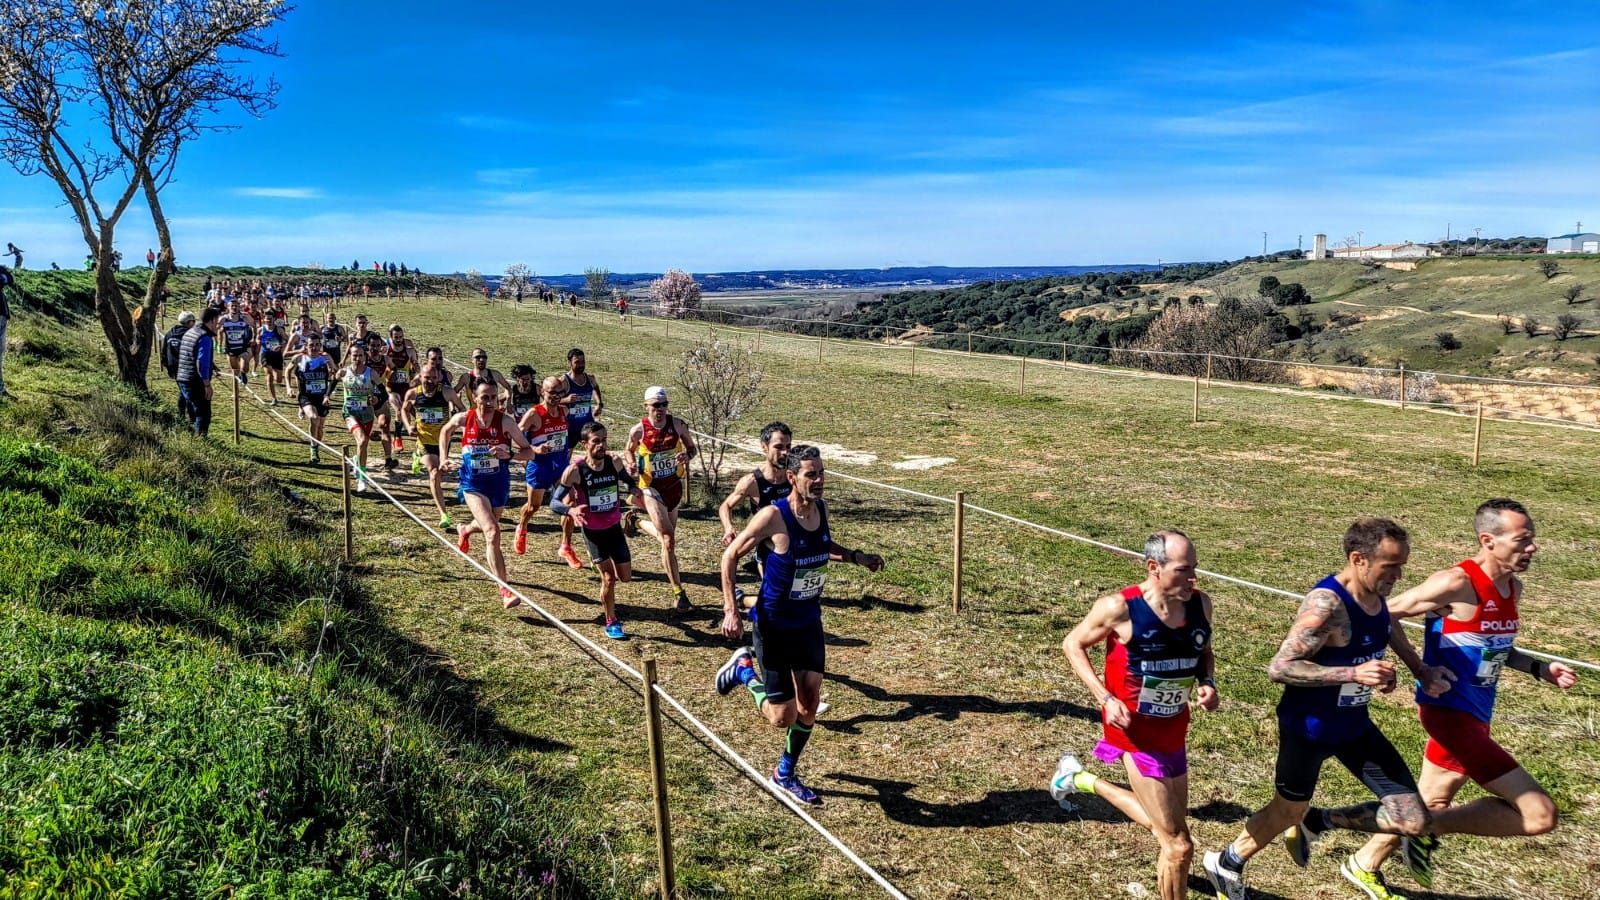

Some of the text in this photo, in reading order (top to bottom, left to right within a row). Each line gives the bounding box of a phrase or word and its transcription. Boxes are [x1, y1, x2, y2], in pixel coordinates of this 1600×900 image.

[479, 460, 491, 468] 98
[599, 494, 611, 505] 53
[802, 577, 821, 591] 354
[1152, 690, 1183, 704] 326
